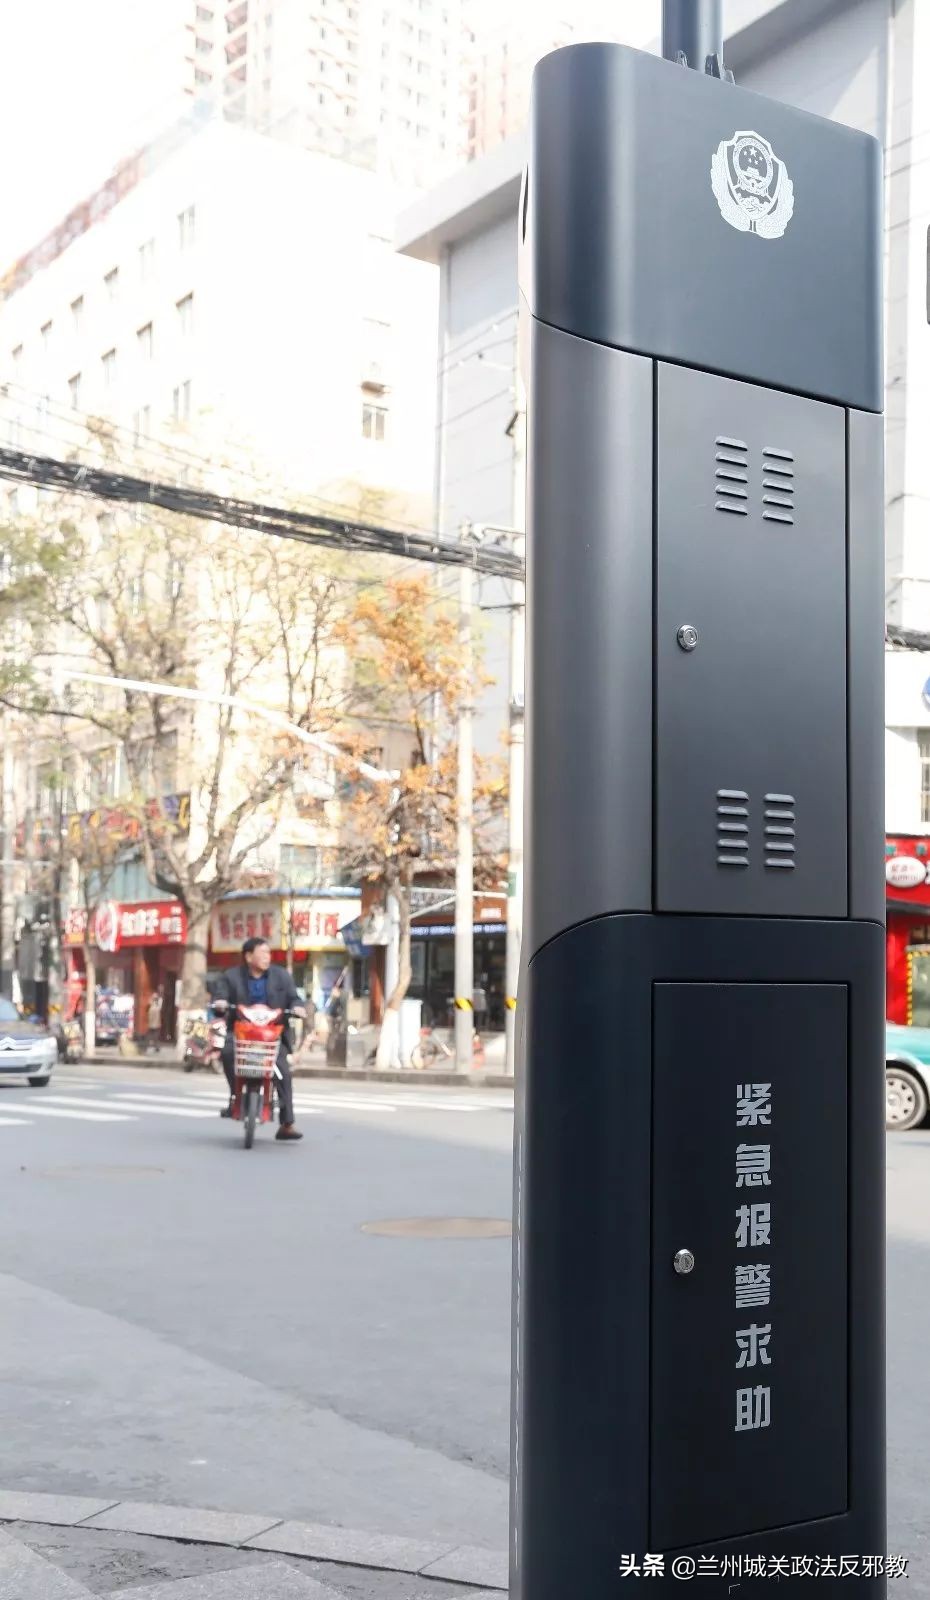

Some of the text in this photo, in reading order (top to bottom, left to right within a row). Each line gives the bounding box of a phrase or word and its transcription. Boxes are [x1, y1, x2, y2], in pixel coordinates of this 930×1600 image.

[734, 1083, 772, 1432] 紧急报警求助
